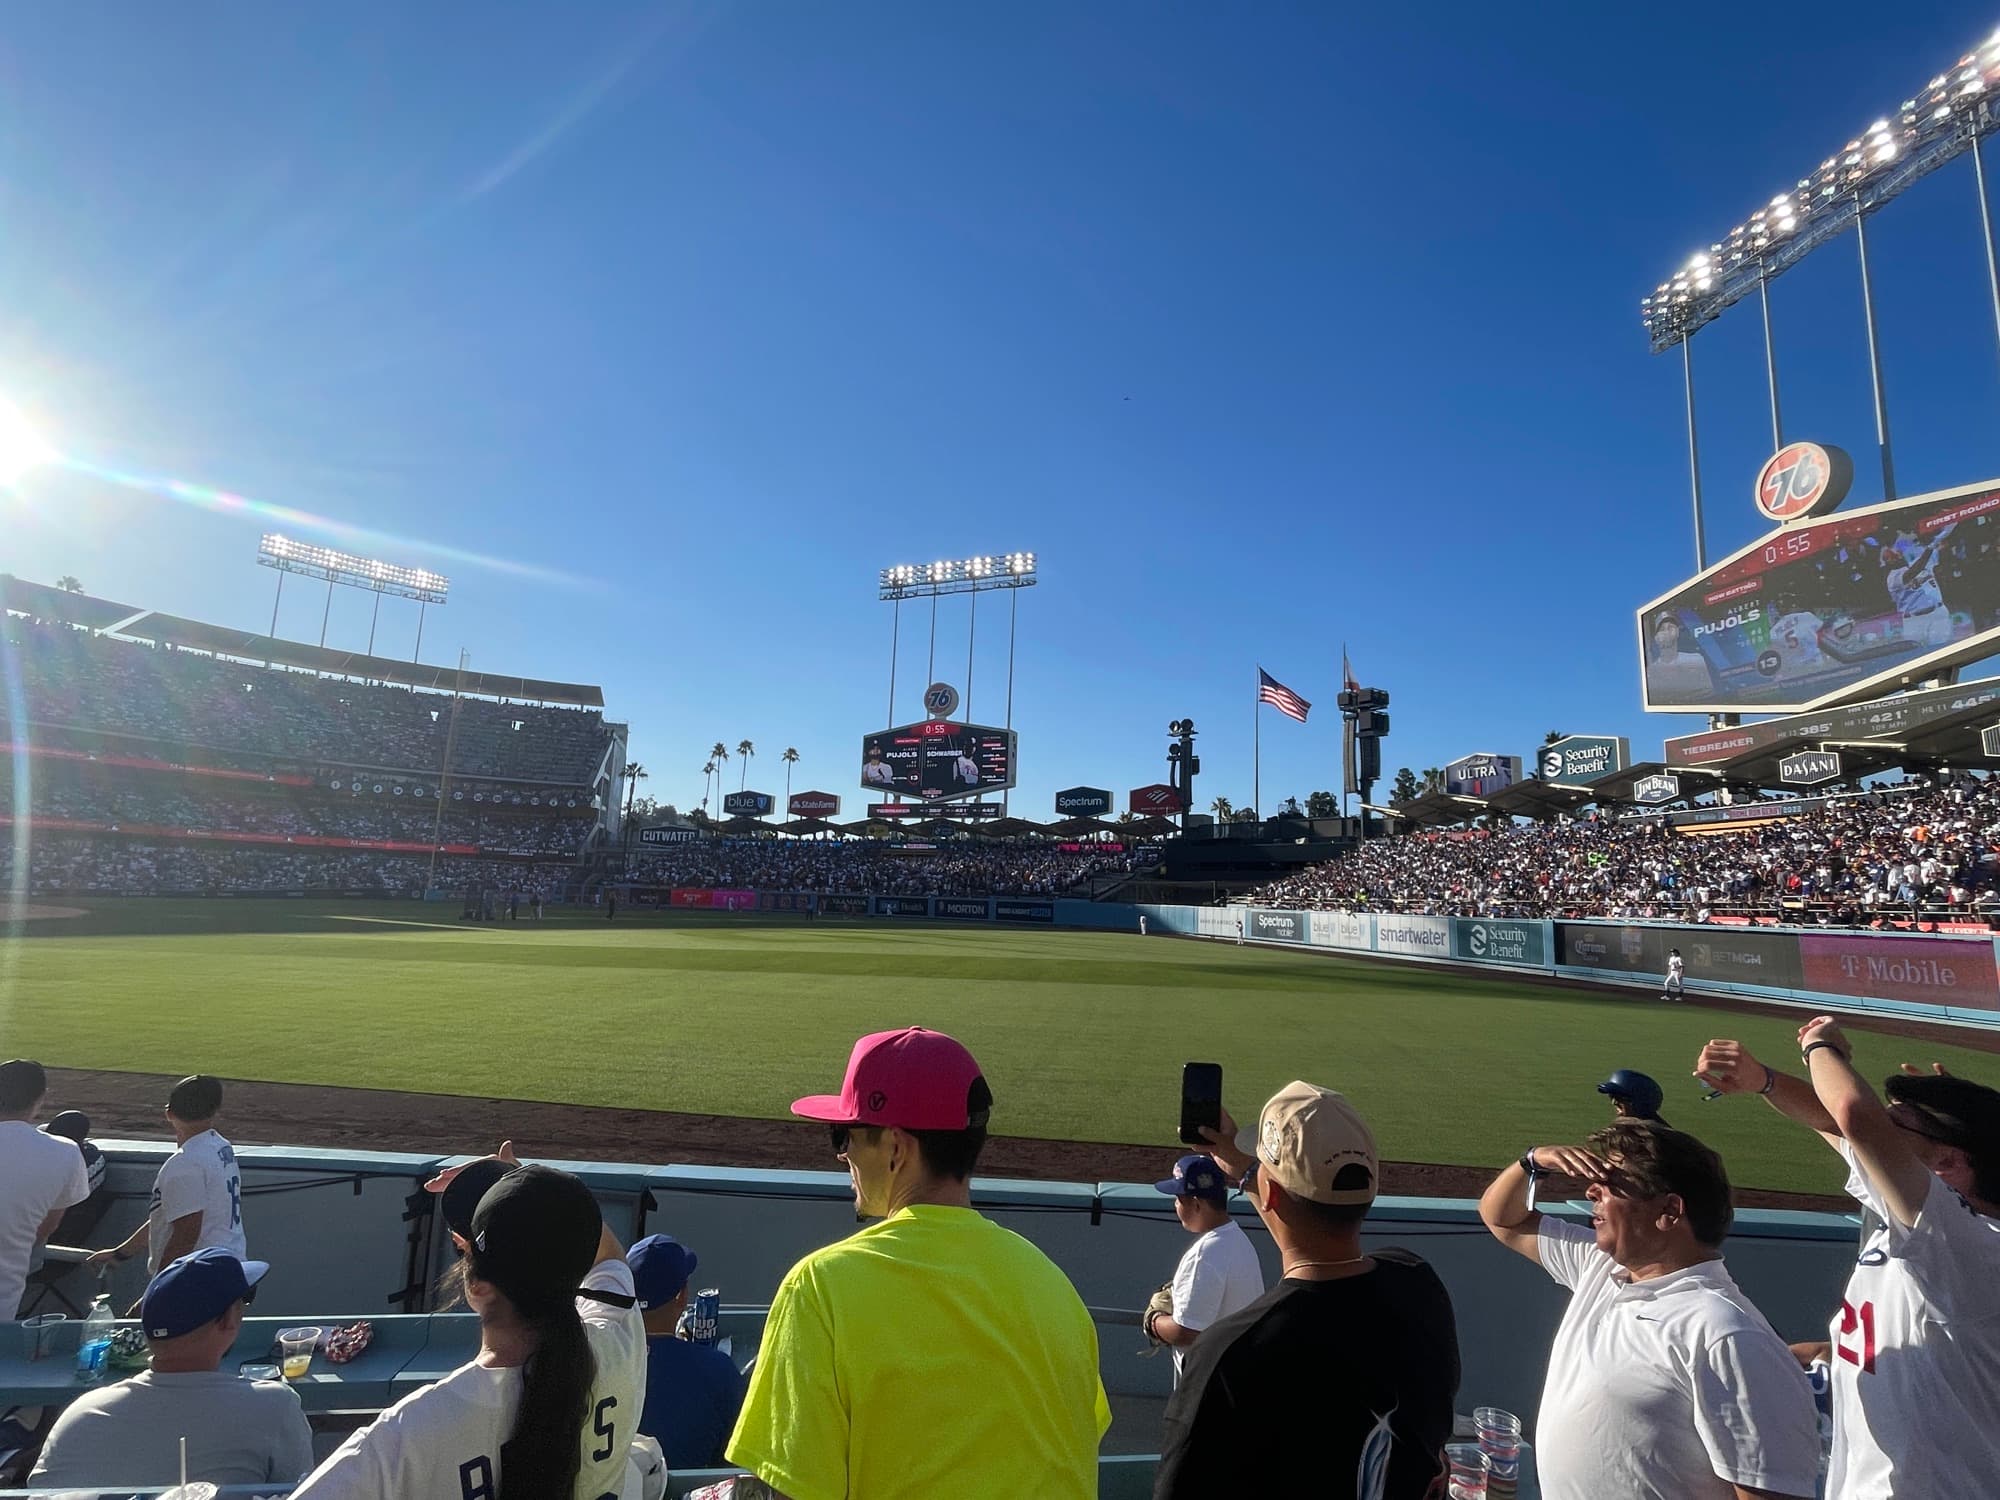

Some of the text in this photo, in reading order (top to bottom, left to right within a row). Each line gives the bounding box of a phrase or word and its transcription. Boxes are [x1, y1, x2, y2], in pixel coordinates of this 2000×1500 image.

[1766, 450, 1821, 511] 76
[1926, 498, 2000, 528] FIRST ROUND
[1764, 533, 1811, 563] 0:55
[1727, 600, 1761, 616] ALBERT
[1693, 609, 1761, 639] PUJOLS
[1759, 658, 1778, 670] 13
[929, 689, 951, 707] 76
[1863, 698, 1910, 711] TRACKER
[1869, 709, 1908, 724] 421'
[925, 725, 945, 734] 0:55
[1799, 722, 1833, 736] 385'
[1565, 745, 1611, 762] Security
[1682, 737, 1754, 756] TIEBREAKER
[1457, 765, 1497, 781] ULTRA
[1567, 759, 1605, 776] Benefit
[1783, 758, 1836, 778] DASANI
[1637, 781, 1652, 799] JIM
[1651, 777, 1676, 794] BEAM
[728, 796, 754, 808] blue
[1058, 797, 1103, 808] Spectrum
[946, 903, 984, 914] MORTON
[1258, 914, 1295, 929] Spectrum
[1340, 924, 1358, 936] blue
[1379, 925, 1446, 946] smartwater
[1490, 925, 1529, 946] Security
[1491, 944, 1524, 961] Benefit
[1712, 951, 1761, 965] BETMGM
[1867, 957, 1957, 986] Mobile
[1838, 1298, 1876, 1375] 21
